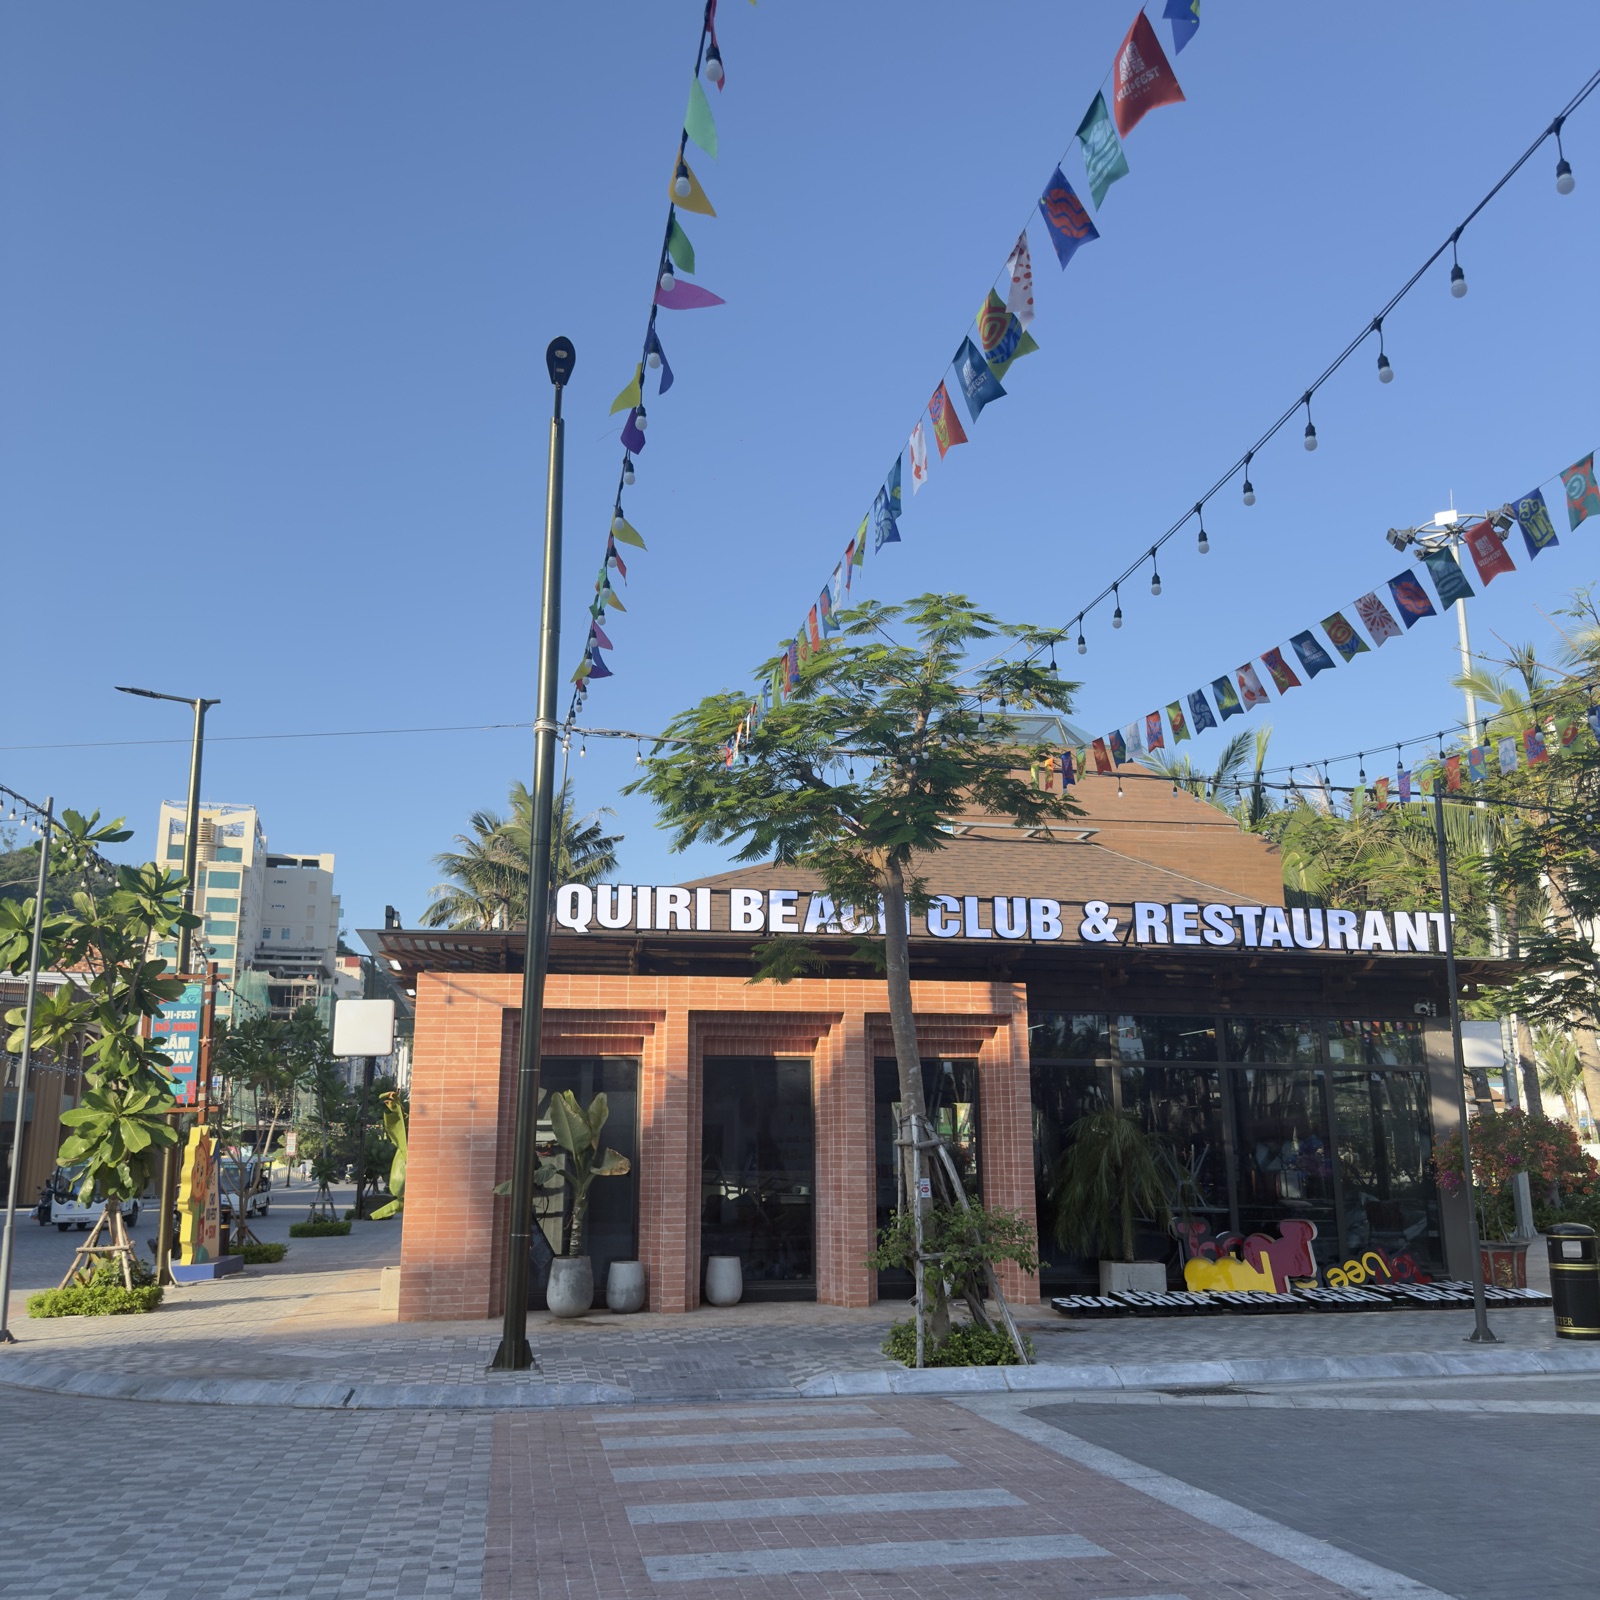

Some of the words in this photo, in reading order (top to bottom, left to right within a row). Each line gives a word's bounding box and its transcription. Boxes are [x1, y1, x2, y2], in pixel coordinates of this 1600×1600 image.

[556, 883, 711, 933] QUIRI
[927, 894, 1062, 941] CLUB
[1080, 901, 1119, 942] &
[1134, 901, 1456, 953] RESTAURANT
